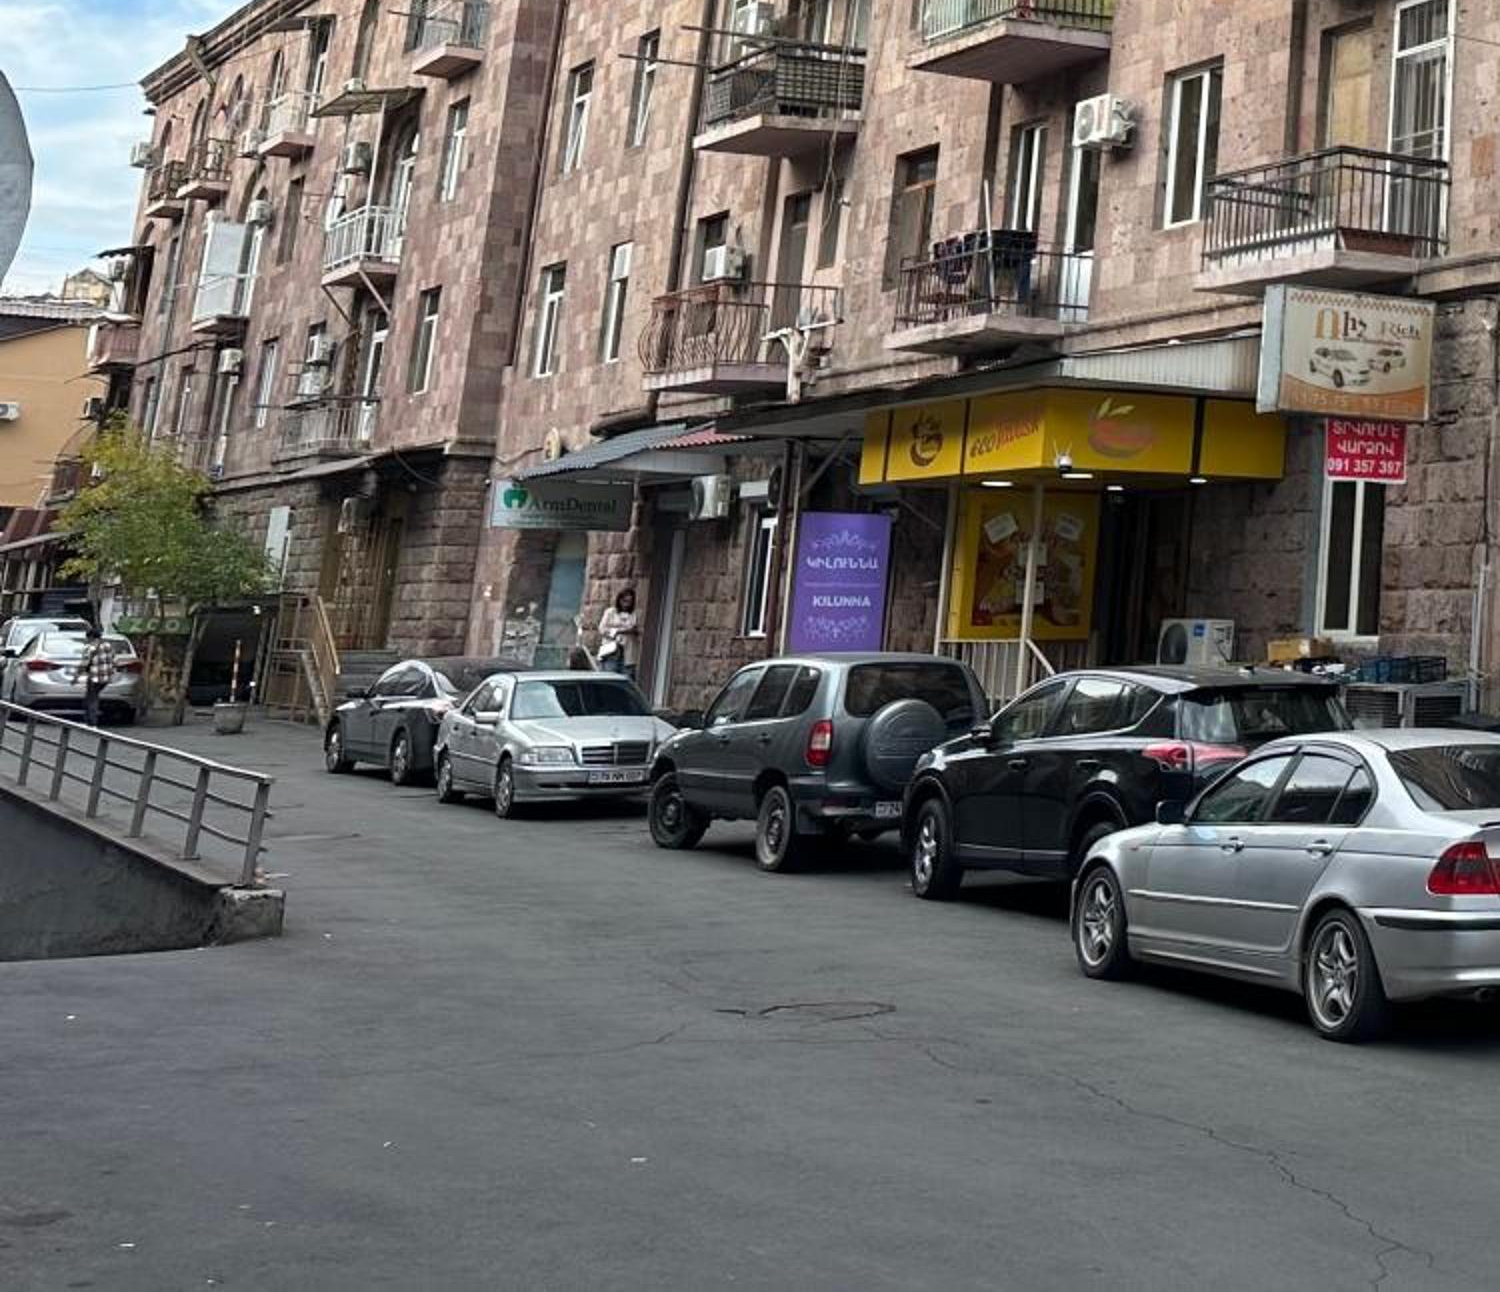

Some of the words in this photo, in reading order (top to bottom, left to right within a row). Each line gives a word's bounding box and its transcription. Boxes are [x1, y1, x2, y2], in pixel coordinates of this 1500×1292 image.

[1328, 457, 1349, 471] 091
[1353, 459, 1375, 473] 357
[1378, 461, 1402, 475] 397
[813, 595, 871, 607] KILUNNA
